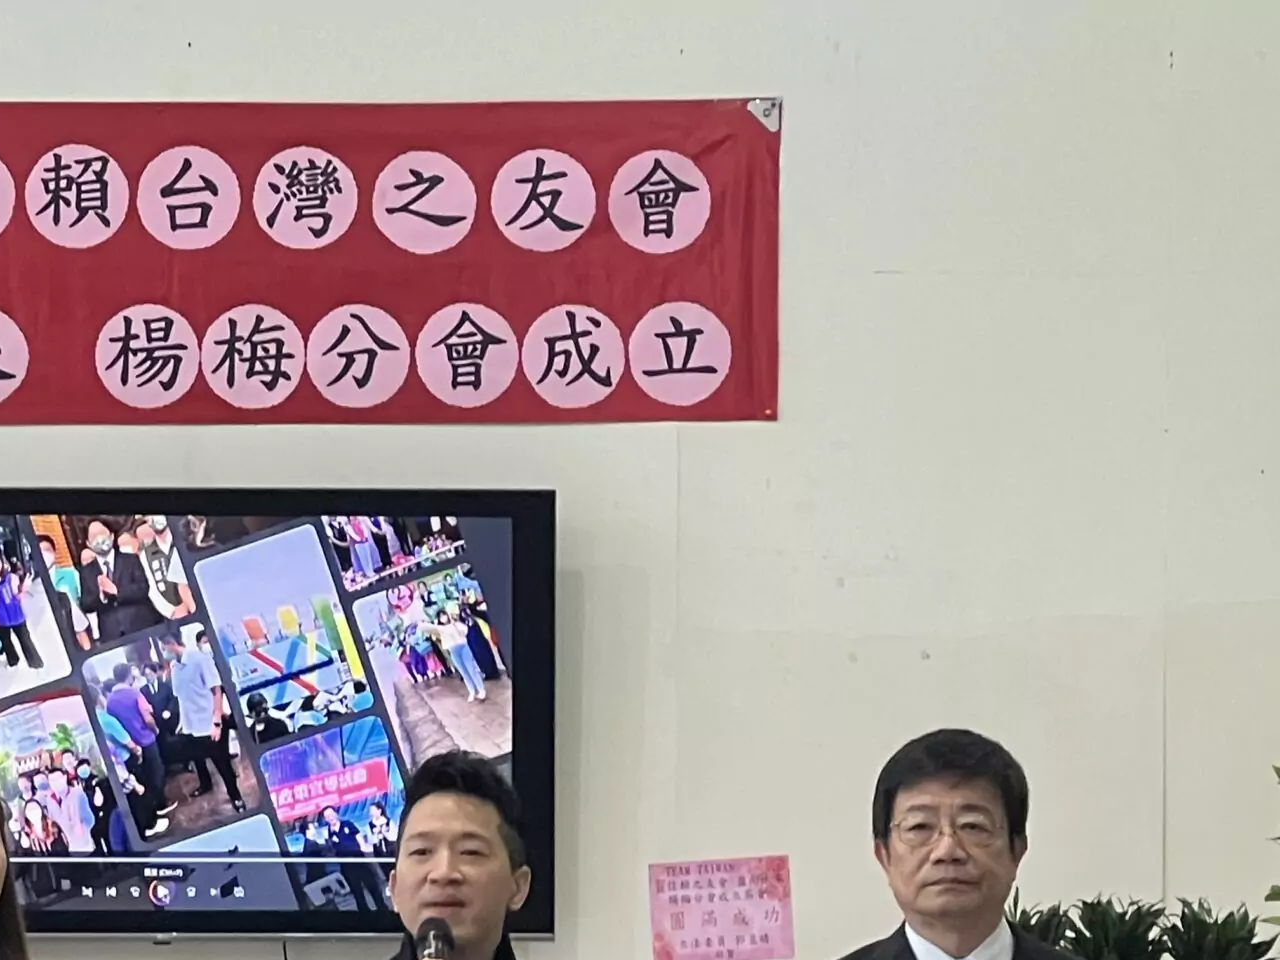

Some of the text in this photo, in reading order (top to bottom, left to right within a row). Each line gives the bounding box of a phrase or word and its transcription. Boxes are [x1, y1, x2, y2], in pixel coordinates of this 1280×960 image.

[108, 310, 720, 392] 楊梅分會成立
